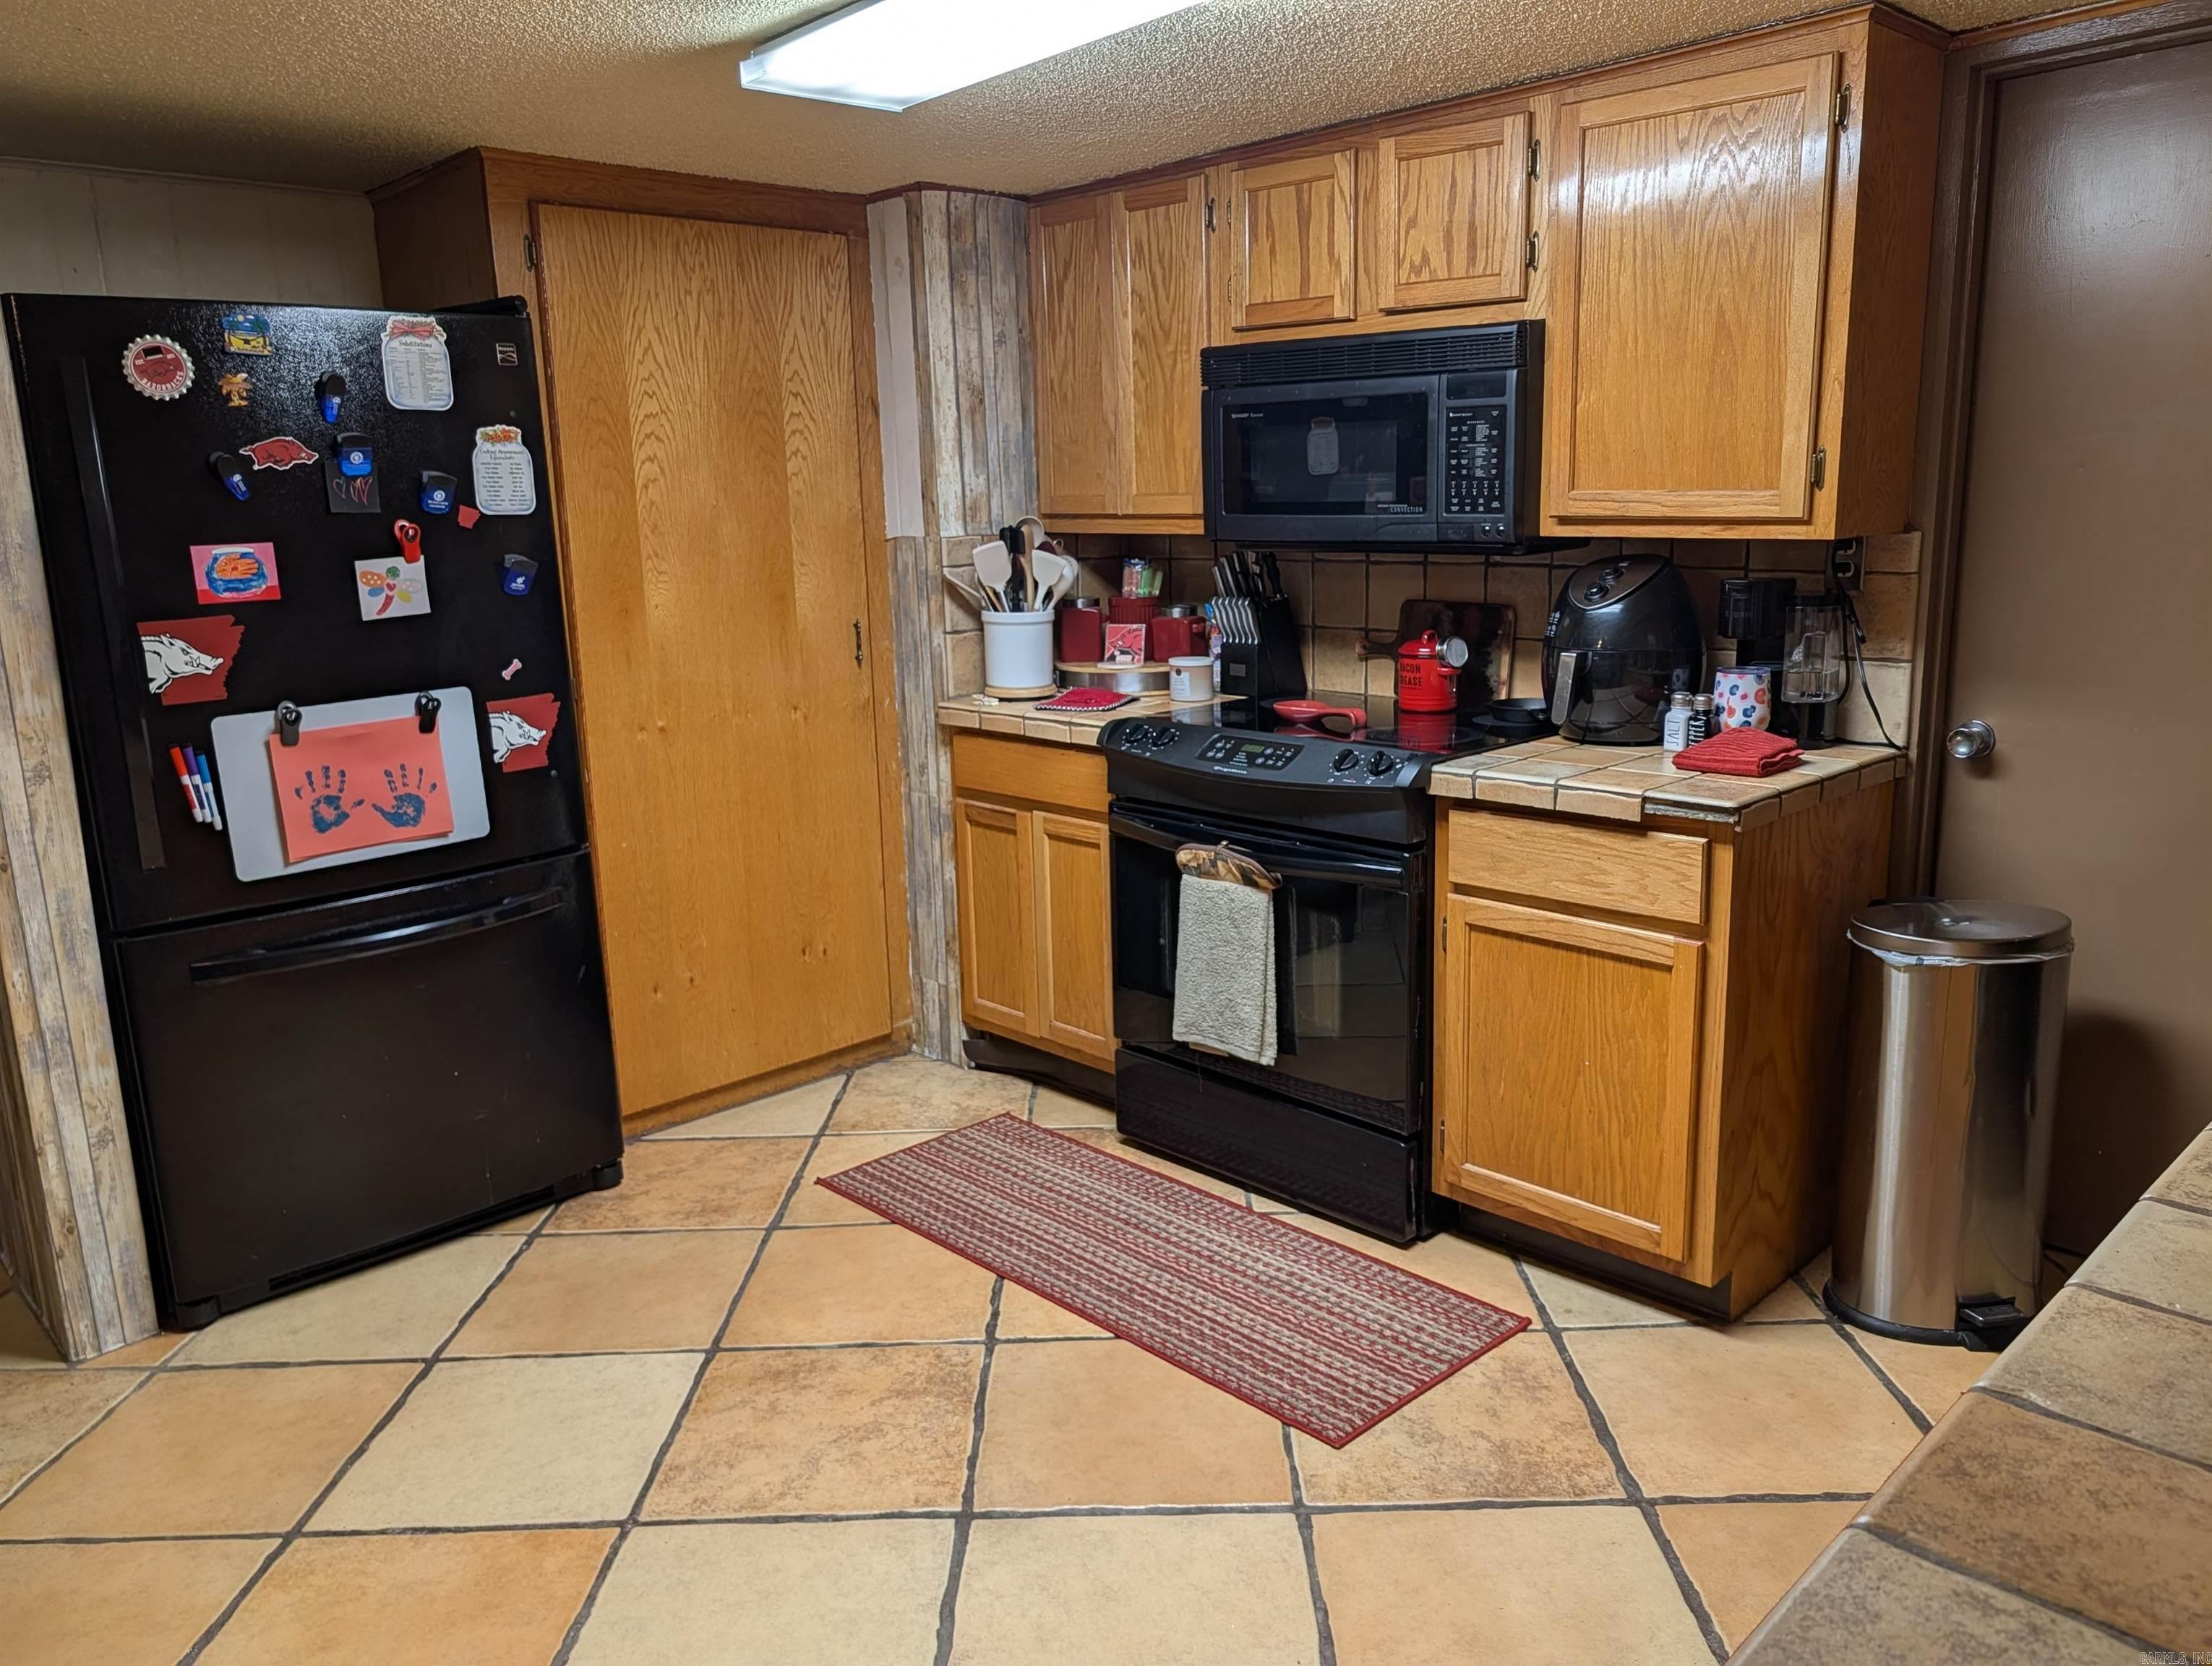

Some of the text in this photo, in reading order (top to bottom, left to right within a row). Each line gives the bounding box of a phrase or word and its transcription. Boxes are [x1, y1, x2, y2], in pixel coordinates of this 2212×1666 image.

[142, 371, 184, 391] RAZORBACKS
[1666, 717, 1681, 747] SALT
[1688, 720, 1705, 749] EPPER
